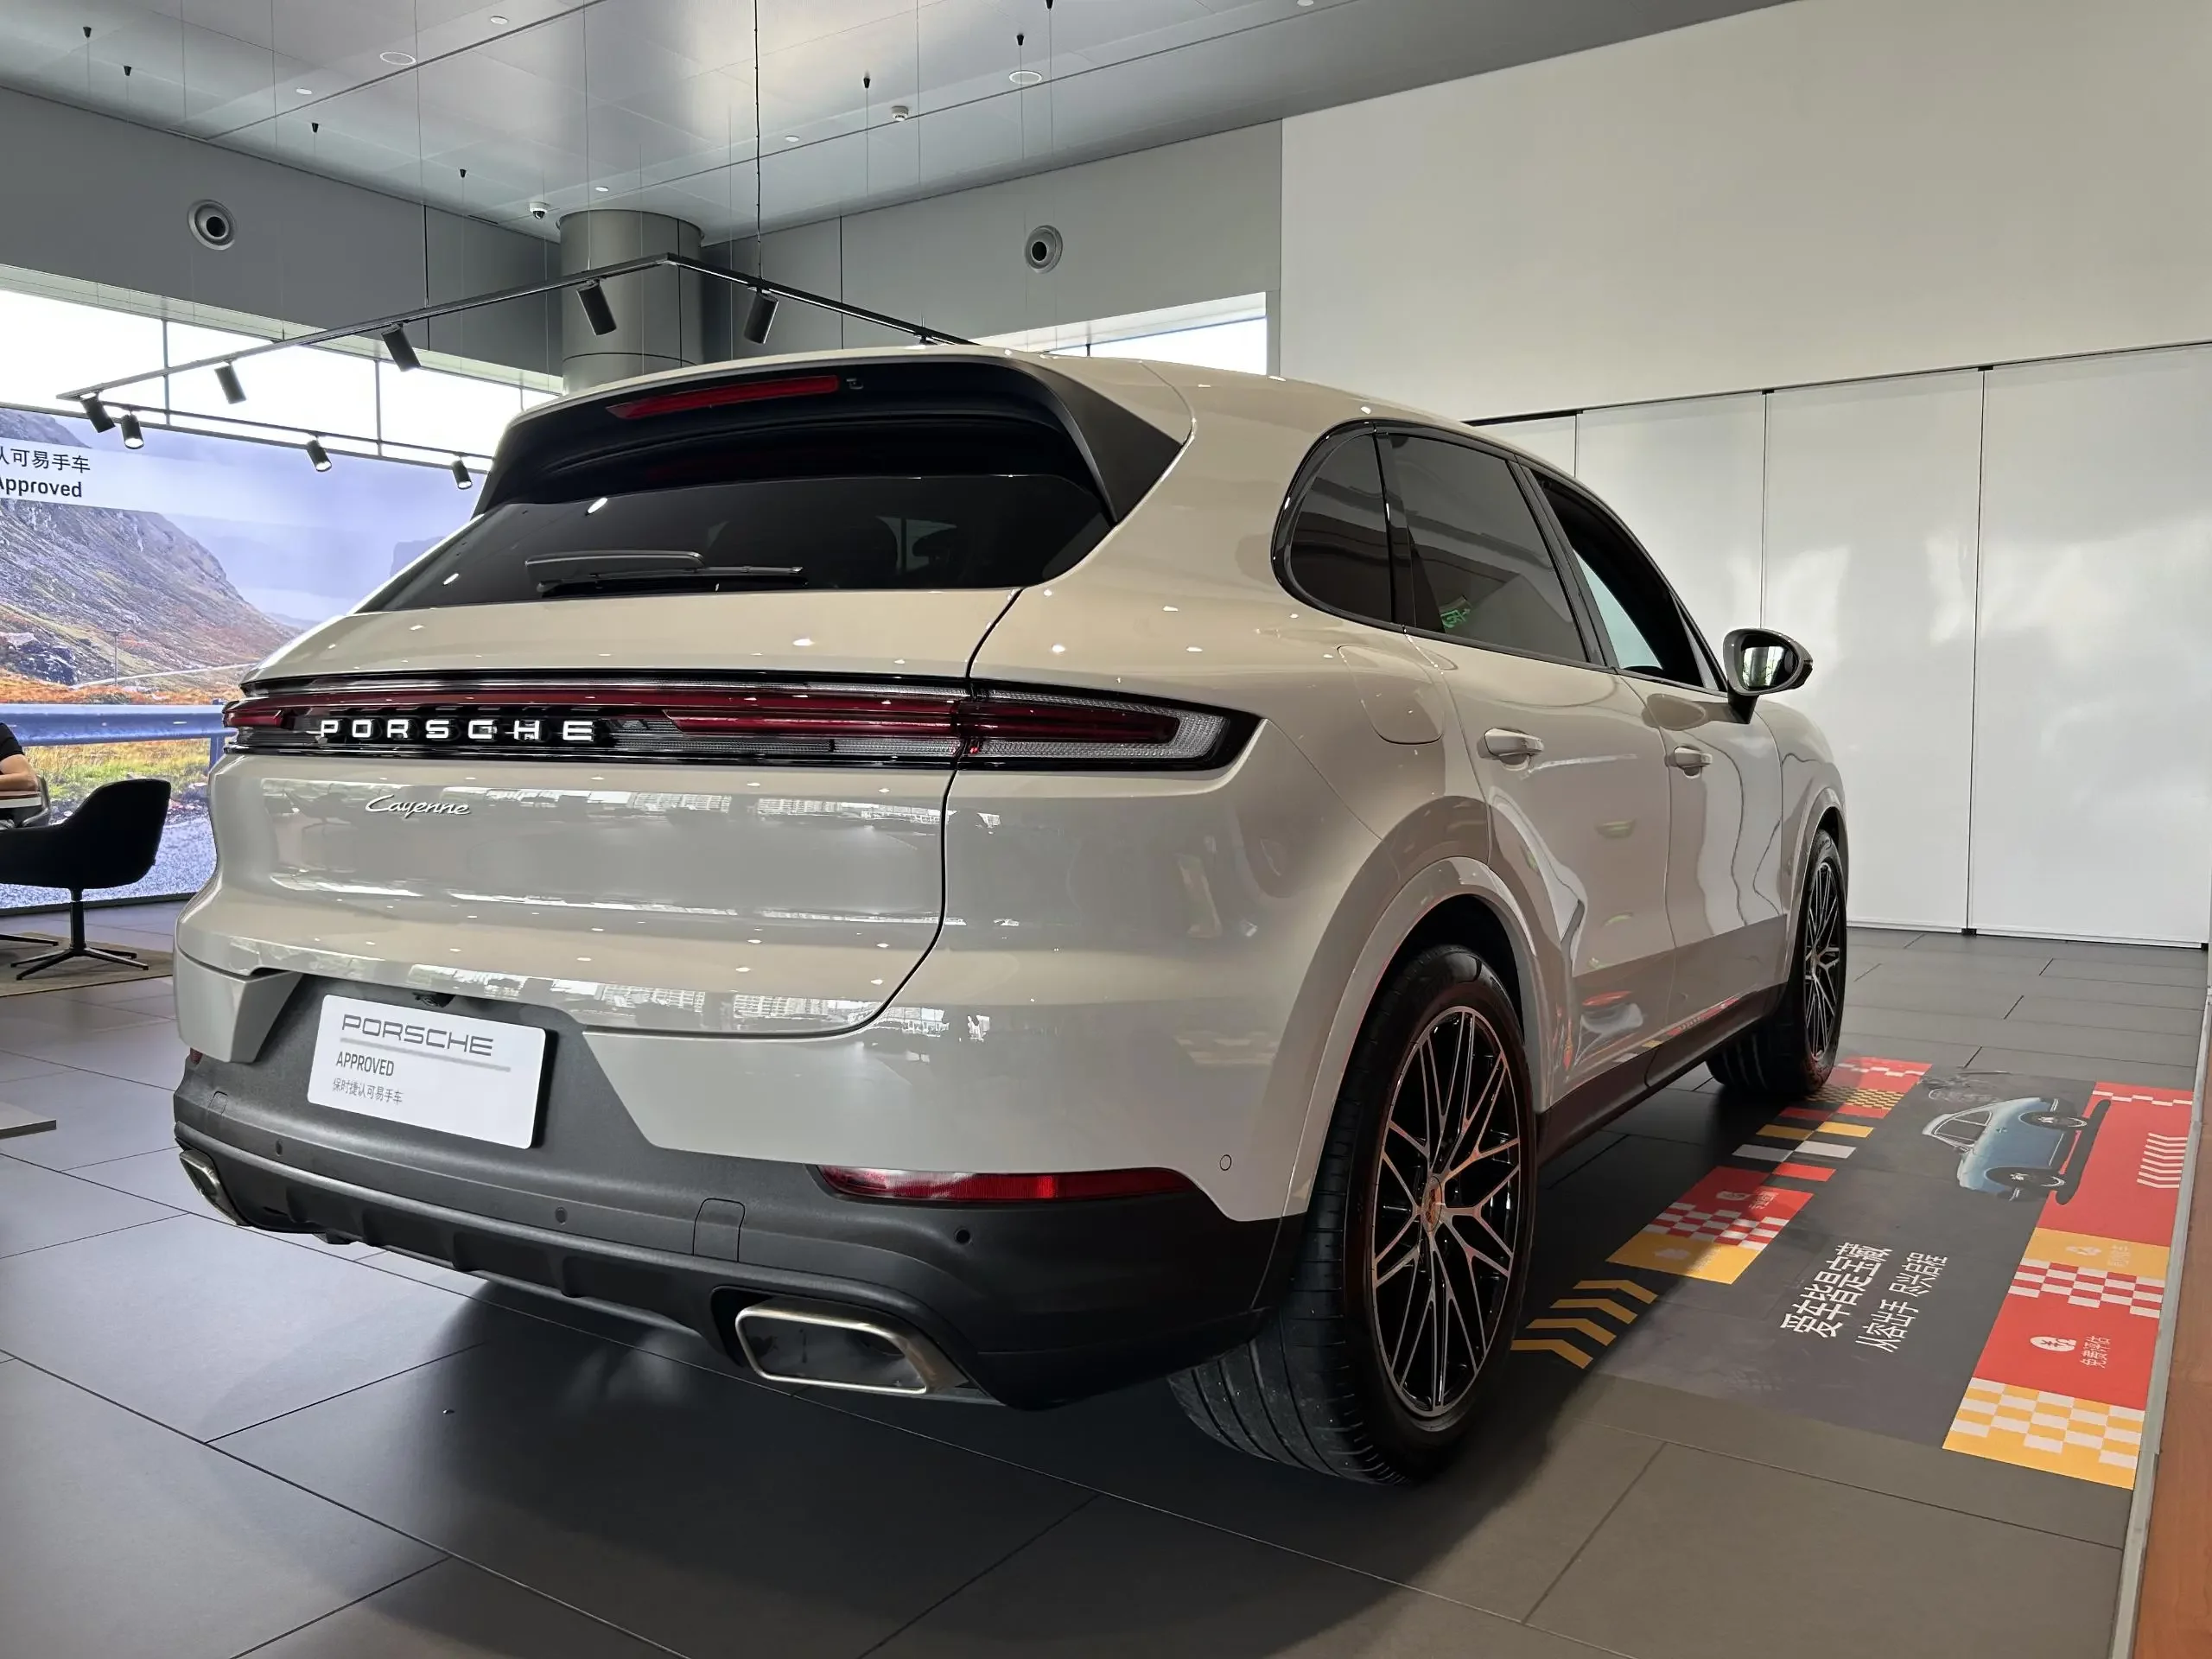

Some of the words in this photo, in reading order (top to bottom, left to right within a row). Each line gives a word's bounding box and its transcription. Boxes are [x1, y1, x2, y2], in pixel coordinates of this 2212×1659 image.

[321, 720, 594, 741] PORSCHE
[365, 794, 471, 817] Cayenne
[342, 1014, 493, 1057] PORSCHE
[335, 1052, 395, 1077] APPROVED
[332, 1077, 404, 1104] 保时捷认可易手车
[1780, 1243, 1893, 1338] 爱车皆是宝藏
[1855, 1300, 1919, 1353] 从容出手
[1889, 1252, 1948, 1297] 尽兴启程
